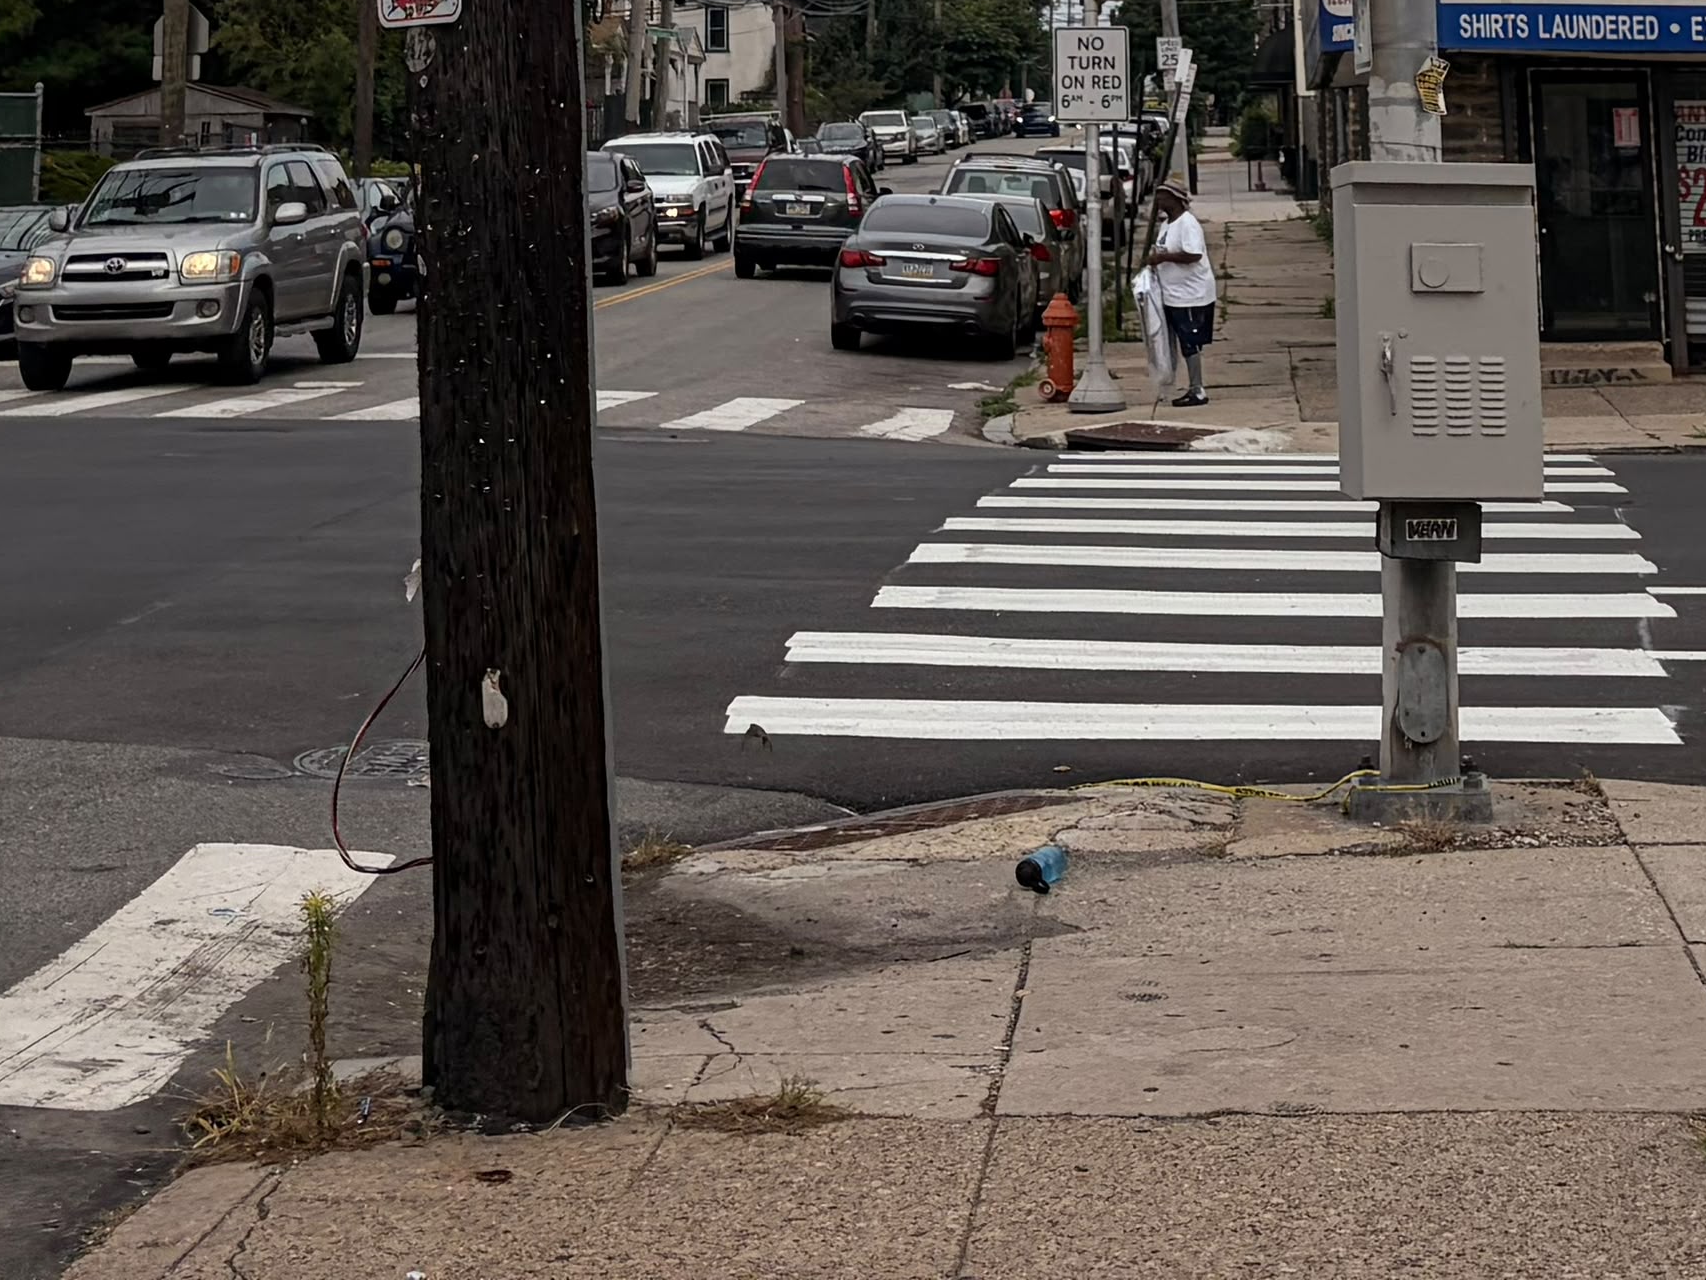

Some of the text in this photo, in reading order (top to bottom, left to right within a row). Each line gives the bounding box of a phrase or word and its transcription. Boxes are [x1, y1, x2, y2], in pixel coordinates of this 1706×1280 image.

[1458, 13, 1529, 39] SHIRTS
[1538, 15, 1660, 41] LAUNDERED
[1077, 36, 1105, 52] NO
[1067, 55, 1116, 71] TURN
[1161, 54, 1178, 67] 25
[1061, 75, 1123, 90] ON RED
